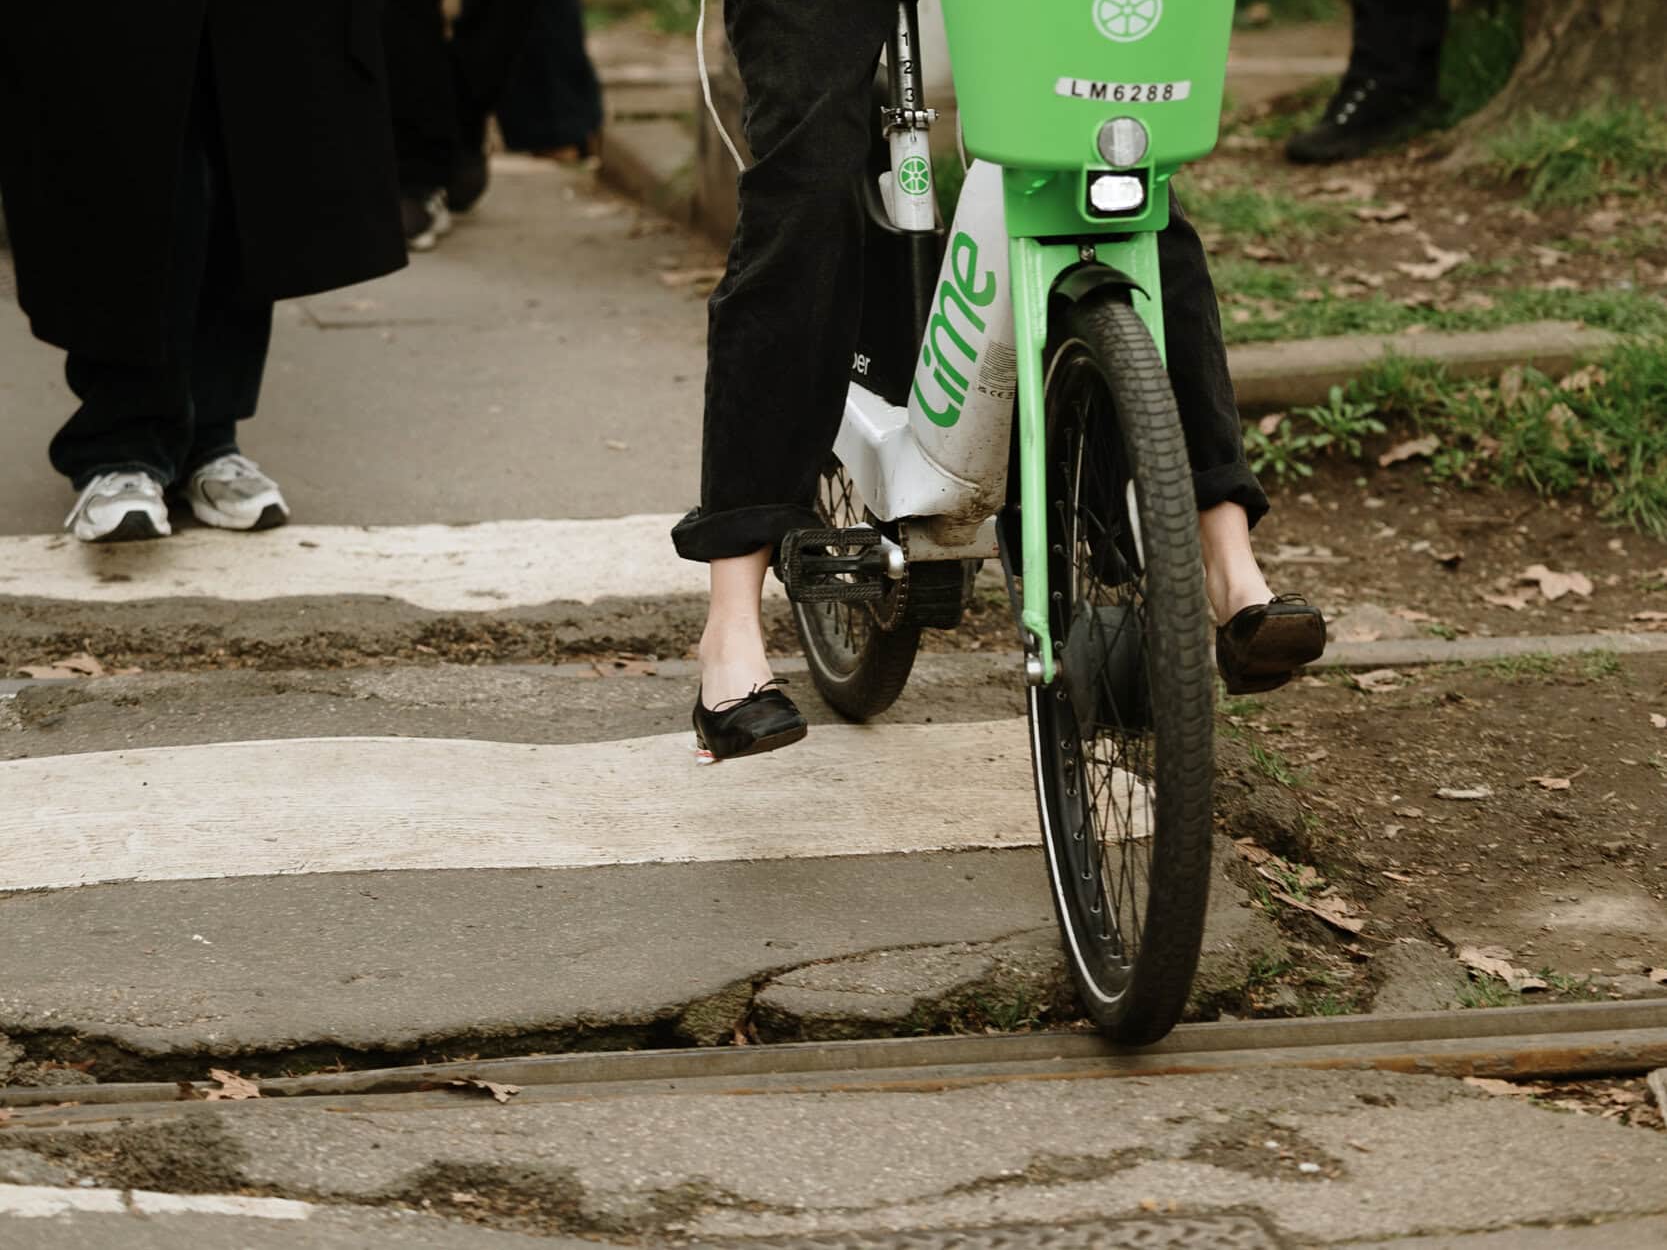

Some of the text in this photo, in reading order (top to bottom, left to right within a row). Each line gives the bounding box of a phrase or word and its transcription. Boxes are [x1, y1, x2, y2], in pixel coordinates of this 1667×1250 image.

[901, 32, 909, 46] 1
[903, 59, 913, 74] 2
[904, 87, 915, 102] 3
[1071, 80, 1174, 101] LM6288
[914, 231, 997, 428] Lime
